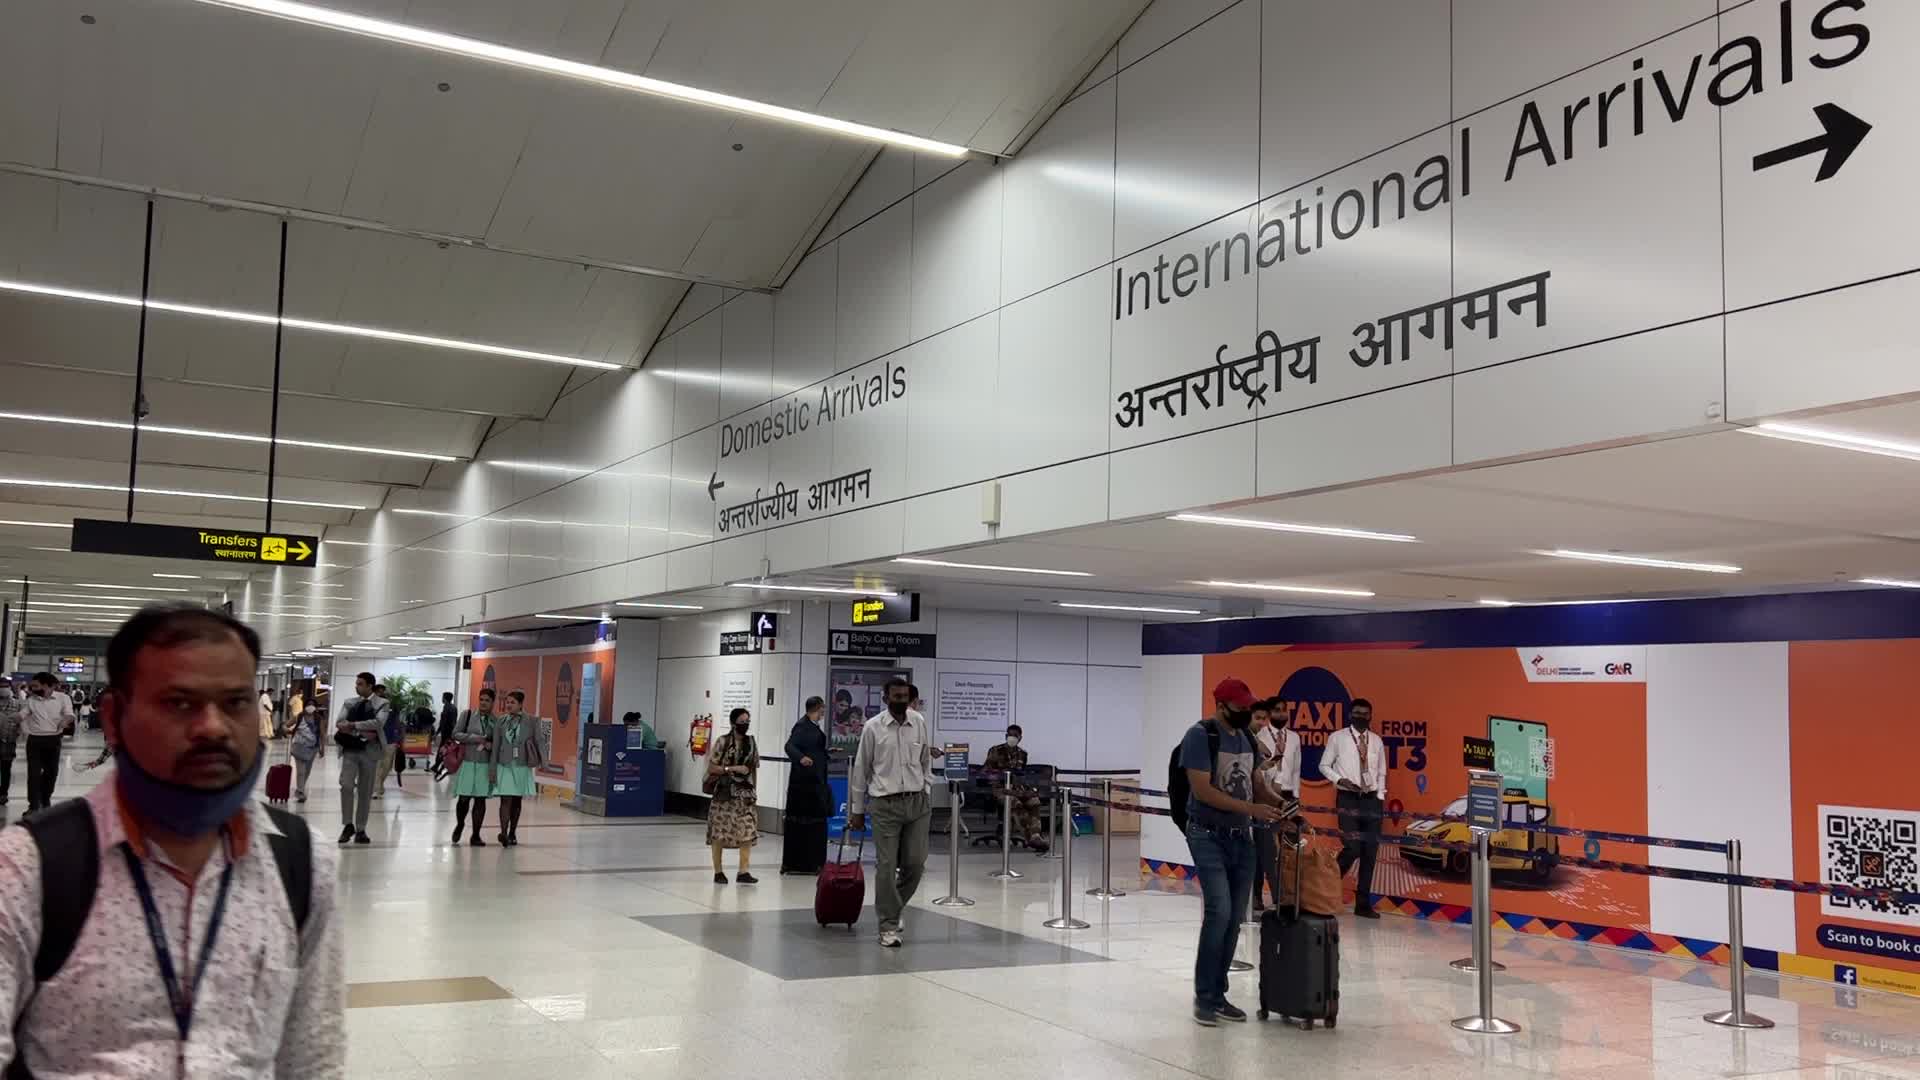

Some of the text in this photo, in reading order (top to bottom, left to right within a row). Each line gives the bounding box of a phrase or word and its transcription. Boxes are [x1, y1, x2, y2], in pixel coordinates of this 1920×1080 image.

[1114, 0, 1870, 320] International Arrivals
[1115, 270, 1551, 428] अन्तर्राष्ट्रीय आगमन
[721, 361, 906, 459] Domestic Arrivals
[718, 468, 872, 533] अन्तर्राज्यीय आगमन
[198, 531, 258, 548] Transfers
[851, 633, 920, 645] Baby Care Room
[1286, 702, 1343, 729] TAXI
[1382, 720, 1427, 736] FROM
[1384, 737, 1427, 771] T3
[1827, 929, 1857, 945] Scan
[1860, 934, 1874, 947] to
[1876, 936, 1911, 953] book
